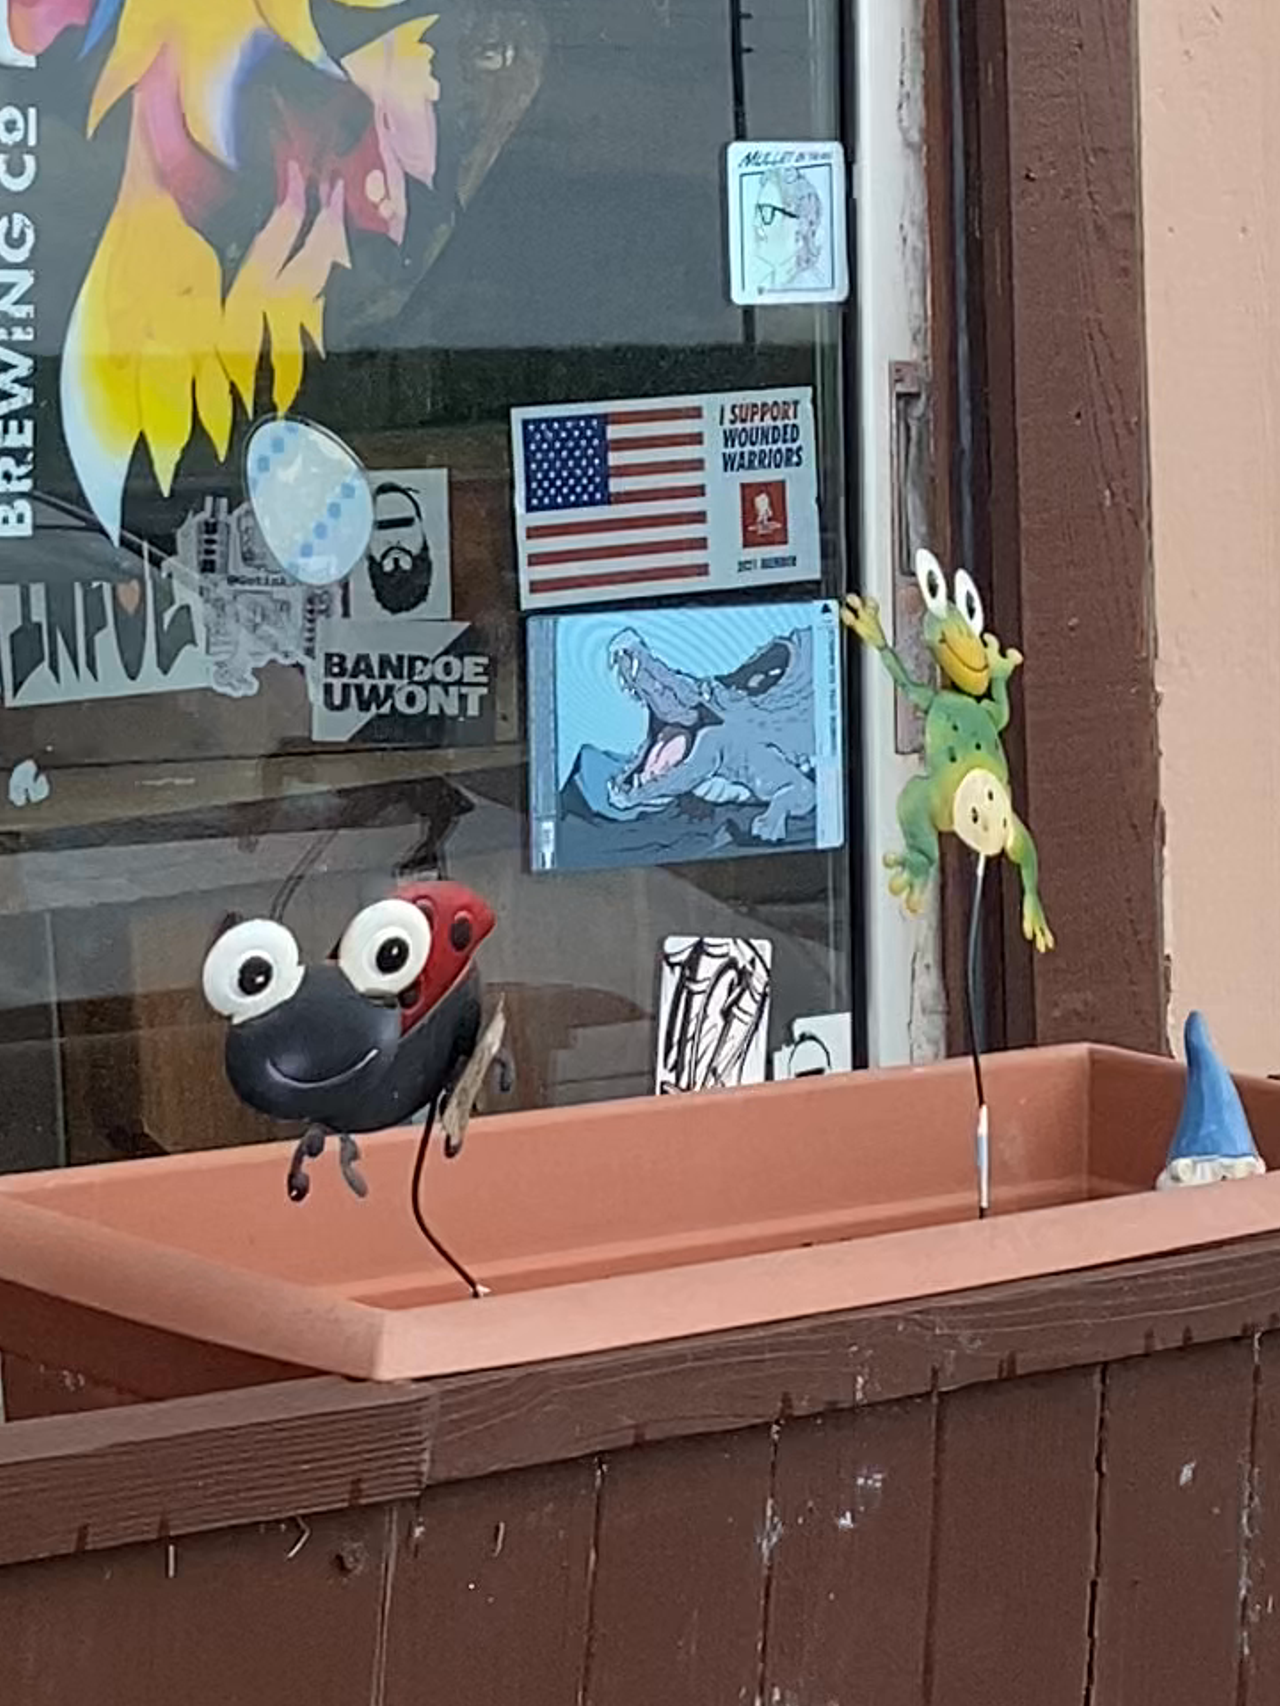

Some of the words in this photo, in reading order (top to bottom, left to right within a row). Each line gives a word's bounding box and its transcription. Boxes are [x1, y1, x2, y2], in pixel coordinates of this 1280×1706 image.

[718, 404, 725, 427] I
[728, 400, 801, 425] SUPPORT
[722, 423, 801, 449] WOUNDED
[721, 445, 804, 473] WARRIORS
